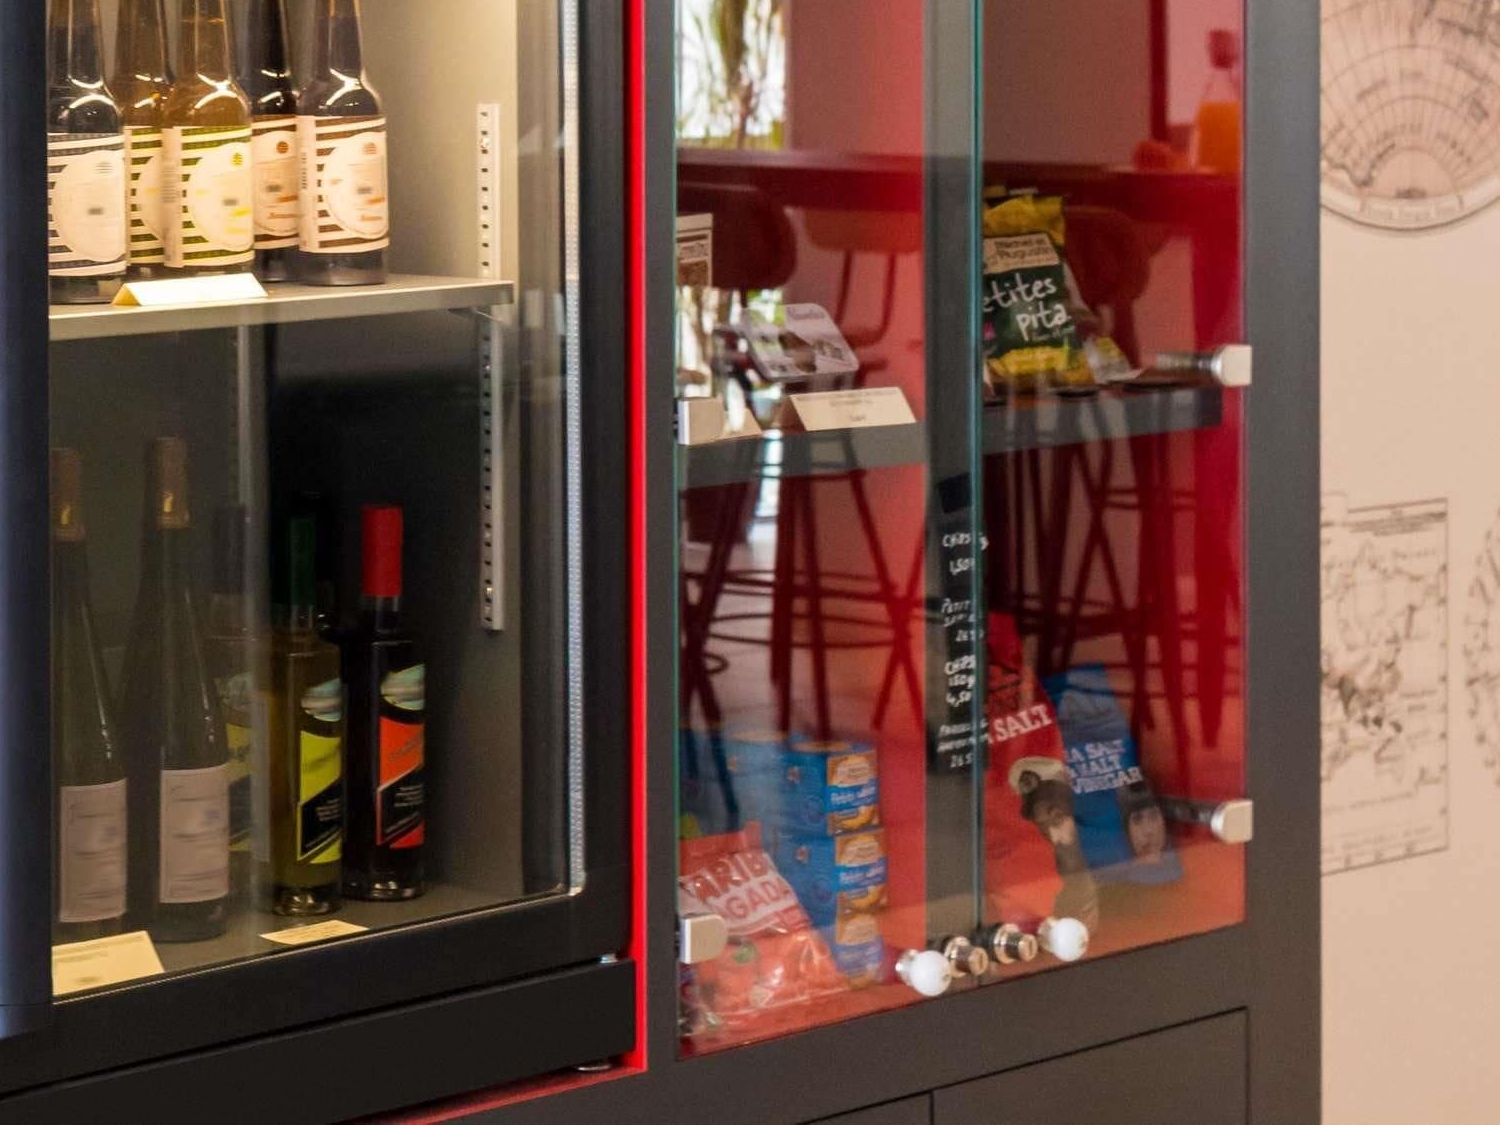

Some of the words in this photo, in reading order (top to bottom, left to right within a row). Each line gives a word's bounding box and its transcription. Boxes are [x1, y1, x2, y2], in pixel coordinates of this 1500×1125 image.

[983, 273, 1058, 313] etites
[1016, 300, 1073, 342] pita
[993, 703, 1053, 743] SALT
